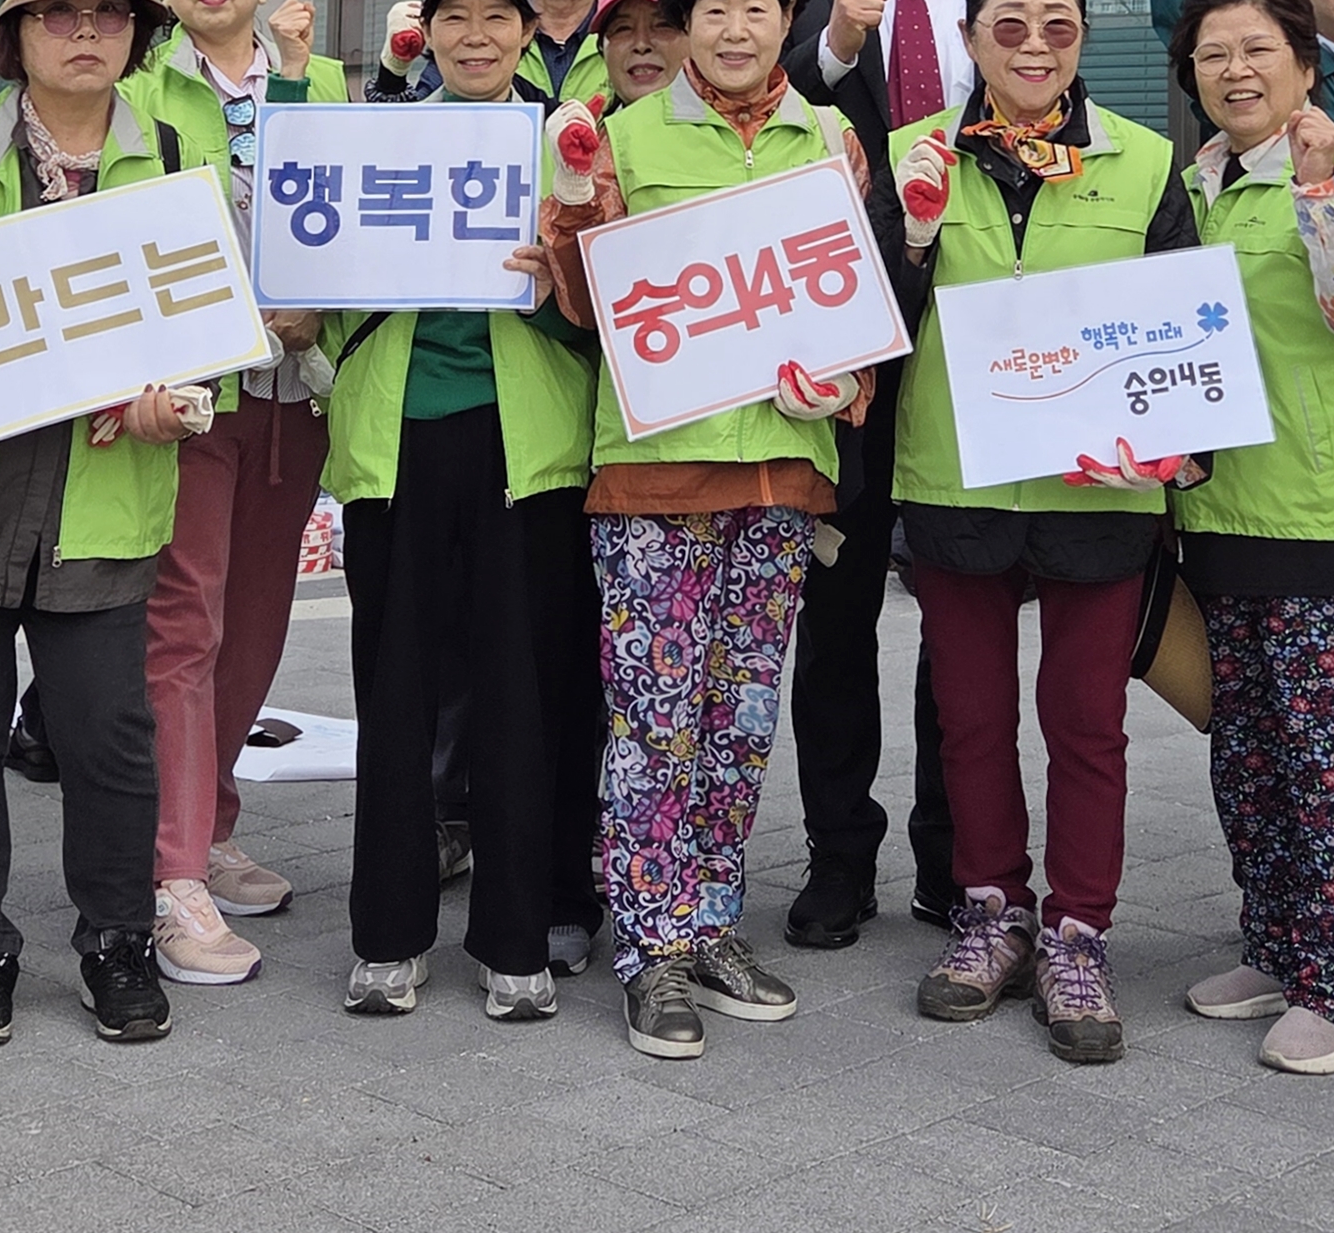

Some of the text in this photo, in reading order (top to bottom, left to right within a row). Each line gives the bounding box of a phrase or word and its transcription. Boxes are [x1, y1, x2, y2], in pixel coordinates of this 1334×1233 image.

[266, 159, 531, 249] 행복한
[612, 218, 864, 364] 숭의4동
[989, 319, 1184, 381] 새로운변화 행복한 미래
[1123, 361, 1225, 416] 숭의4동
